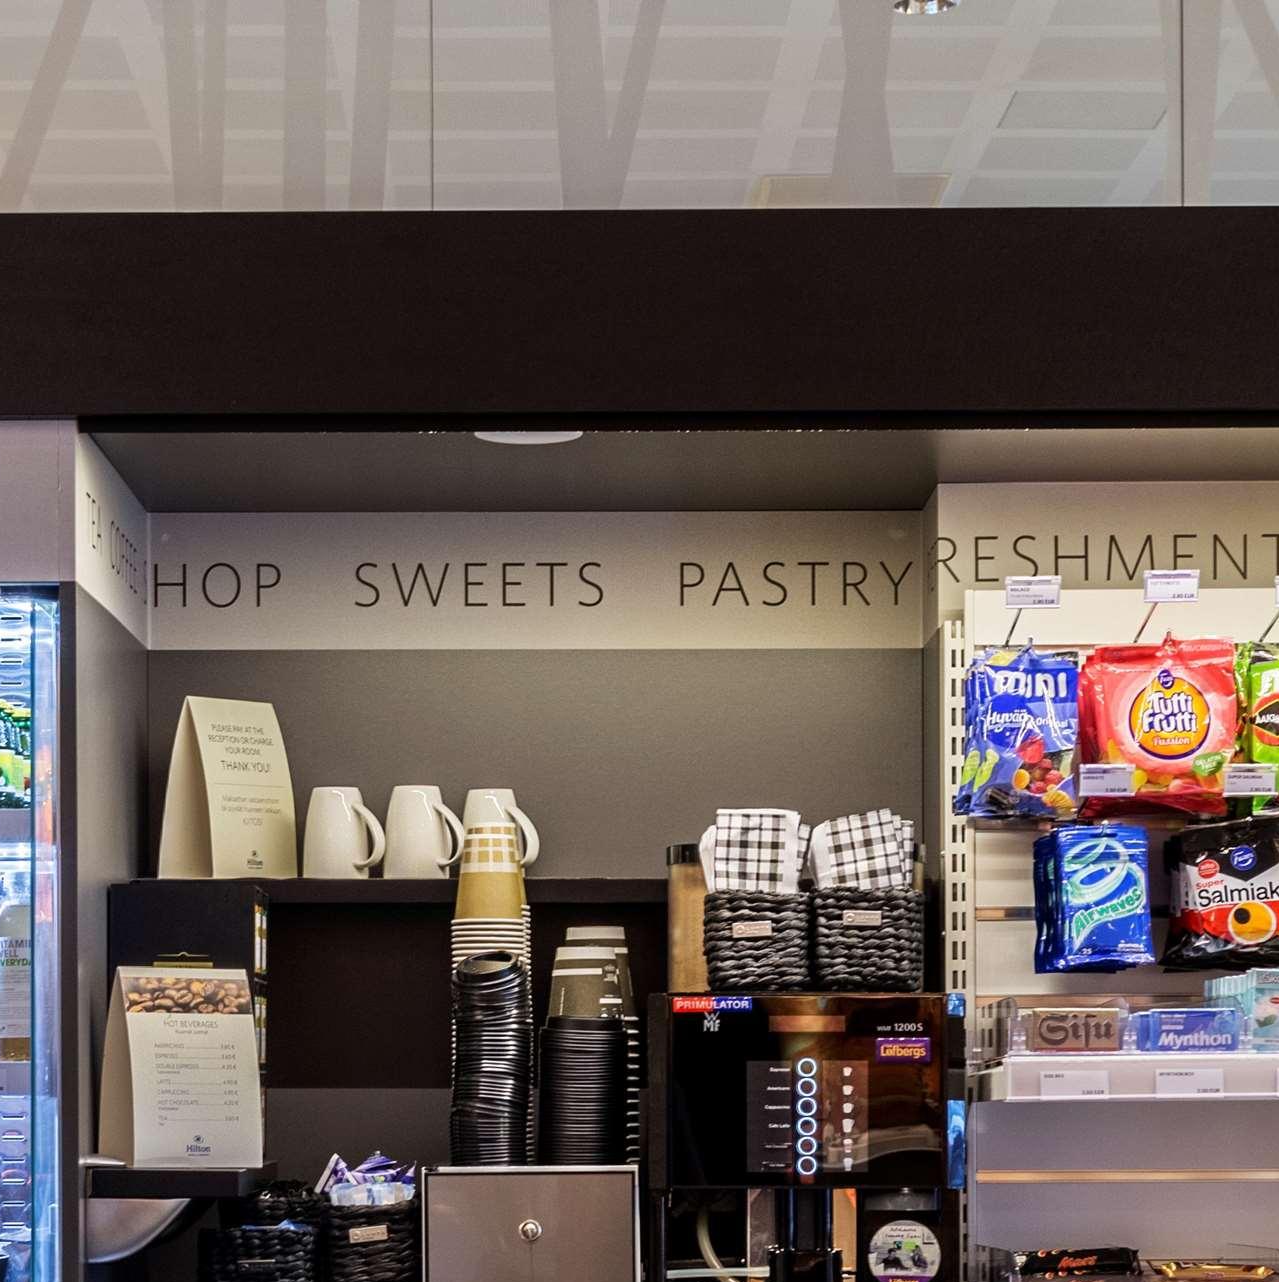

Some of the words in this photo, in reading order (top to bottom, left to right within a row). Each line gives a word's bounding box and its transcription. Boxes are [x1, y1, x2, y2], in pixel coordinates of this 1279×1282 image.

[354, 561, 605, 608] SWEETS
[678, 561, 914, 607] PASTRY
[1148, 690, 1193, 715] Tutti
[1142, 710, 1198, 733] Frutti
[1152, 735, 1192, 746] Passion
[220, 760, 249, 773] THANK
[1195, 879, 1224, 891] Super
[1074, 887, 1142, 932] Airwaves
[675, 997, 751, 1010] PRIMULATOR
[163, 1020, 179, 1028] HOT
[180, 1020, 219, 1029] BEVERAGES
[1158, 1030, 1233, 1048] Mynthon
[186, 1144, 212, 1153] Hilton
